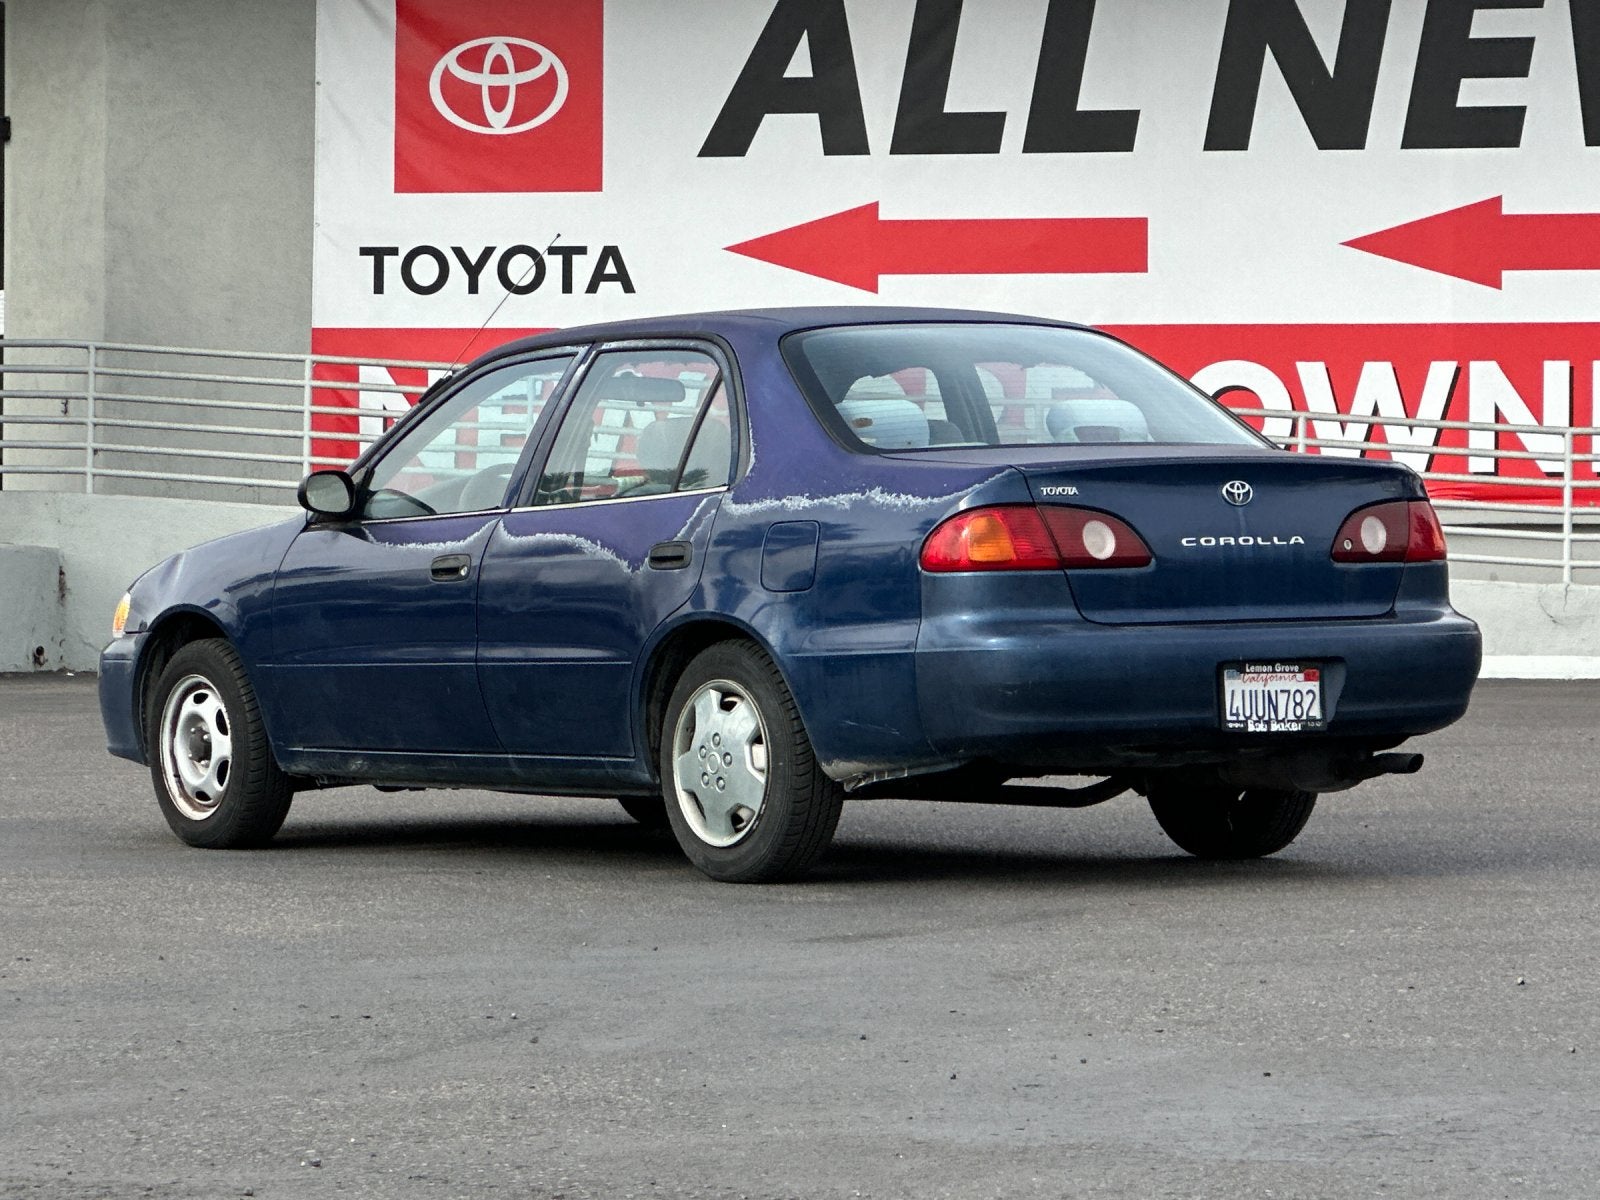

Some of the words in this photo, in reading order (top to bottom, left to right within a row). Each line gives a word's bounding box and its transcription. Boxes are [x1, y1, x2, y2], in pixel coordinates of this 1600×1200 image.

[697, 0, 1141, 157] ALL
[1203, 0, 1600, 151] NE
[359, 245, 636, 295] TOYOTA
[1040, 486, 1079, 496] TOYOTA
[1181, 535, 1305, 547] COROLLA
[1245, 663, 1273, 673] Lemon
[1274, 662, 1299, 673] Grove
[1241, 673, 1298, 688] California
[1229, 689, 1317, 721] 4UUN782
[1247, 720, 1268, 732] Bob
[1270, 719, 1302, 732] Baker
